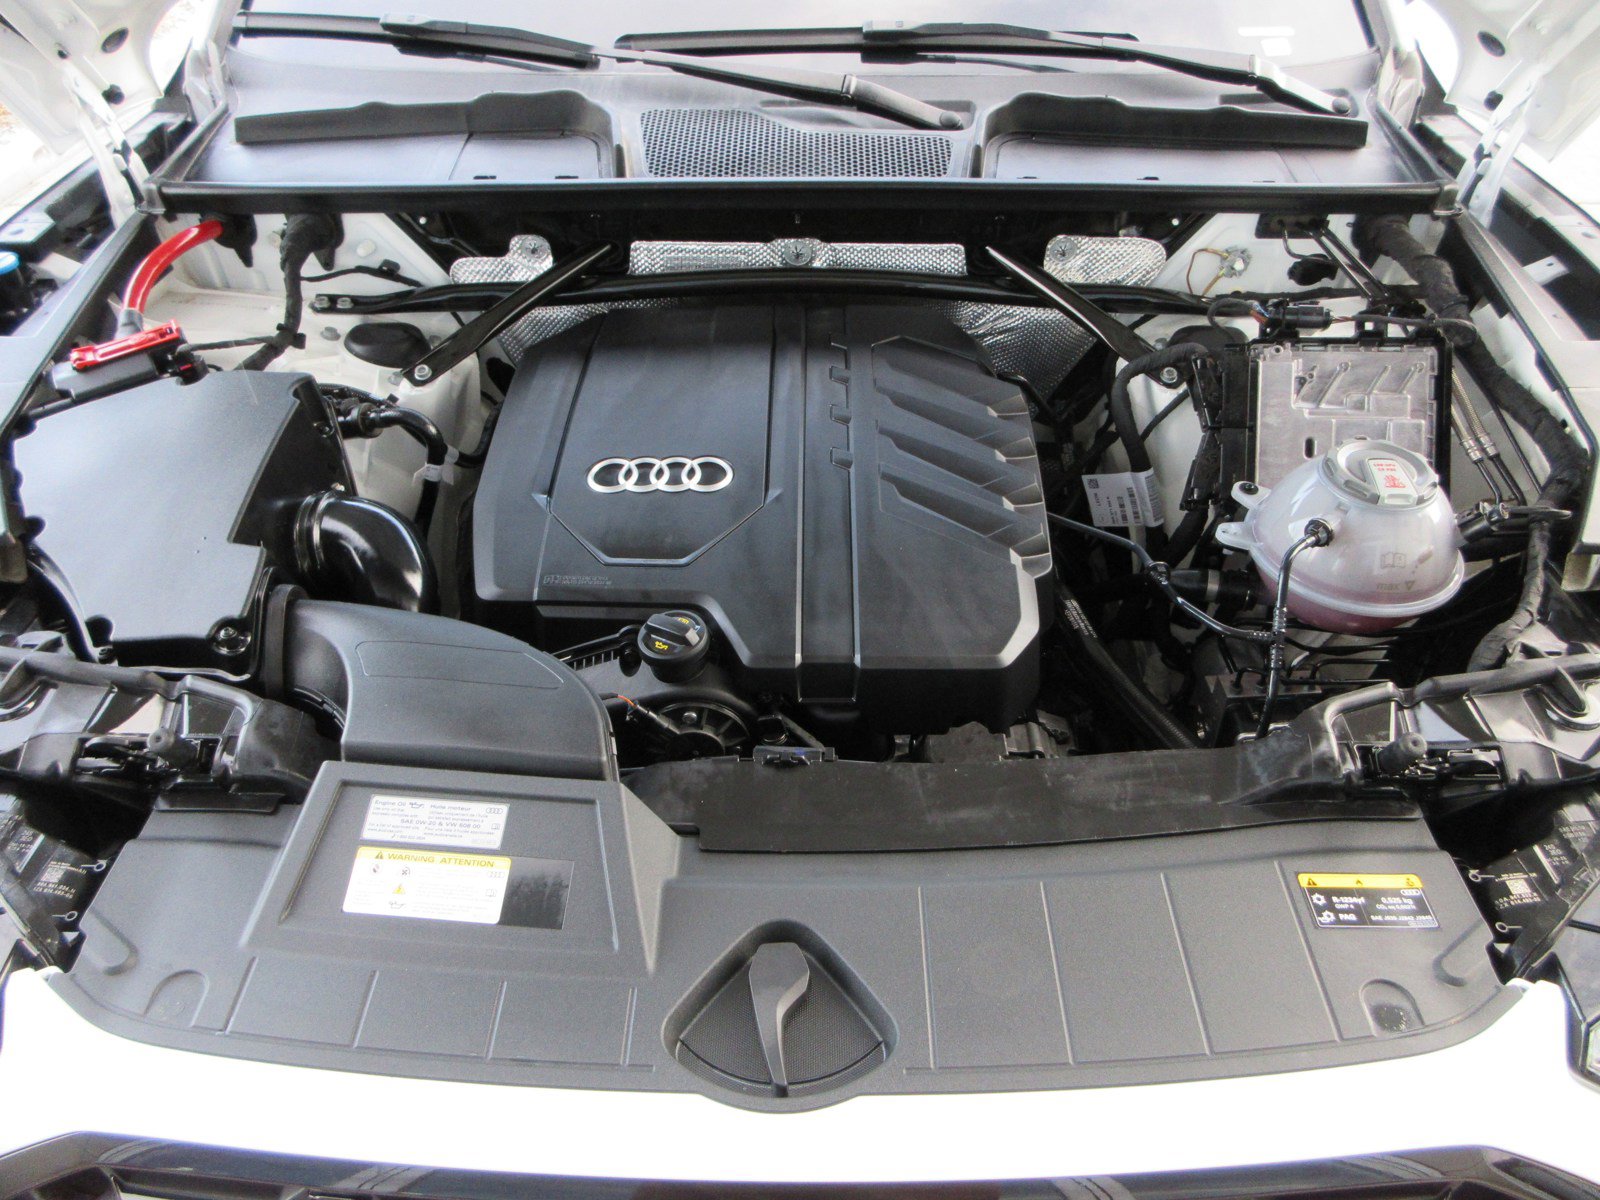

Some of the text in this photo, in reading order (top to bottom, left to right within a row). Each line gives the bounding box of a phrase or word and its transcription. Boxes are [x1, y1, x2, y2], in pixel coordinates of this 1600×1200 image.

[387, 853, 495, 868] WARNING ATTENTION
[1403, 897, 1413, 905] kg
[1338, 913, 1357, 921] PAG
